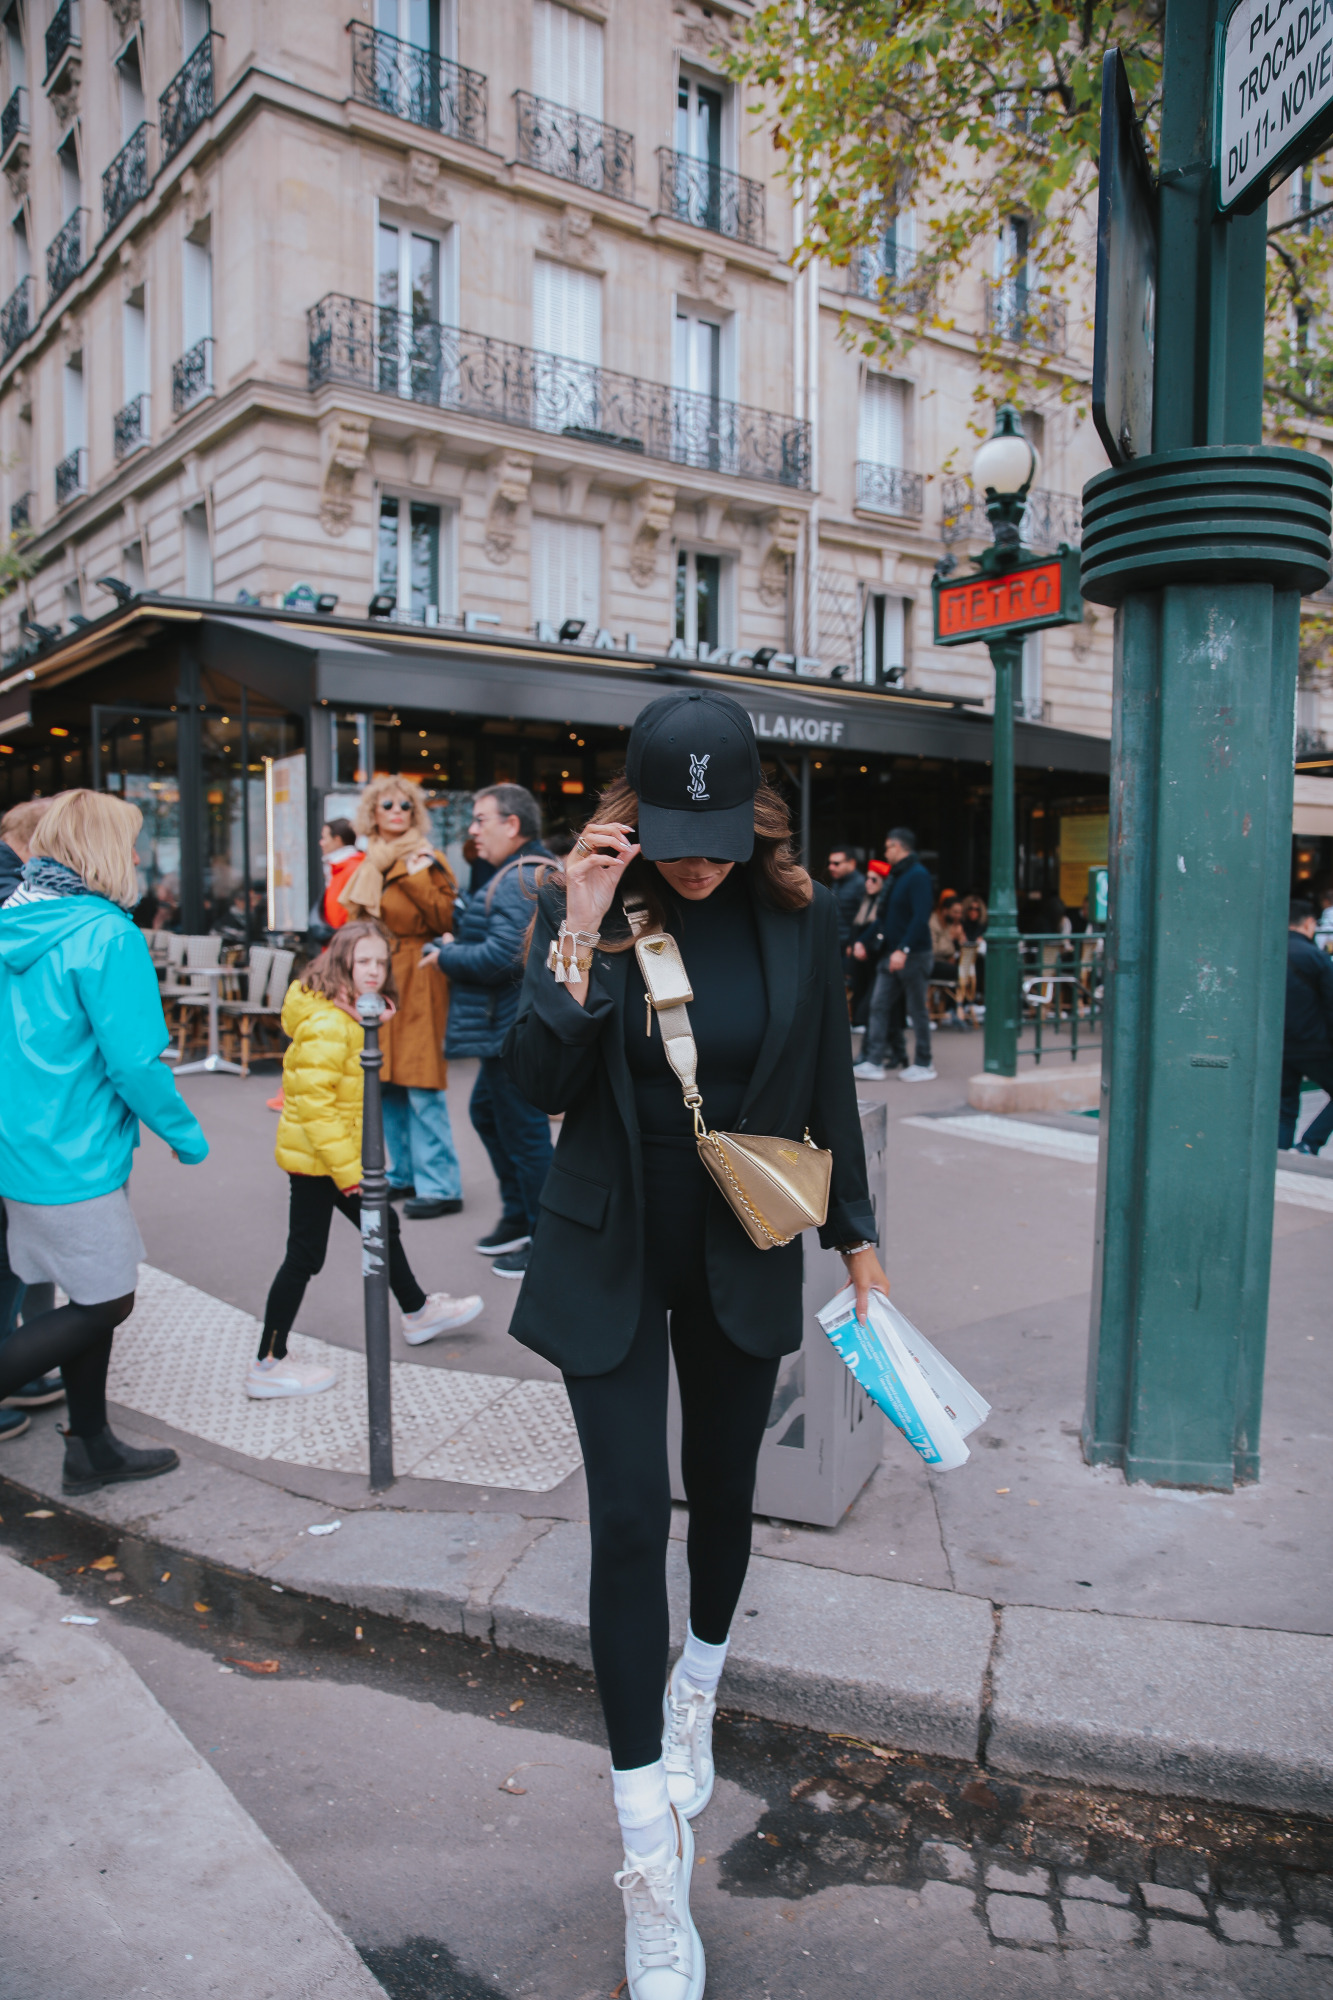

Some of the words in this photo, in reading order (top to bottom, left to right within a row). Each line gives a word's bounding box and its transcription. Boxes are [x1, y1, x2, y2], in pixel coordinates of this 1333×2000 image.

[1228, 130, 1249, 187] DU
[1280, 37, 1333, 131] NOVE
[948, 575, 1051, 627] METRO
[912, 1437, 937, 1459] 75
